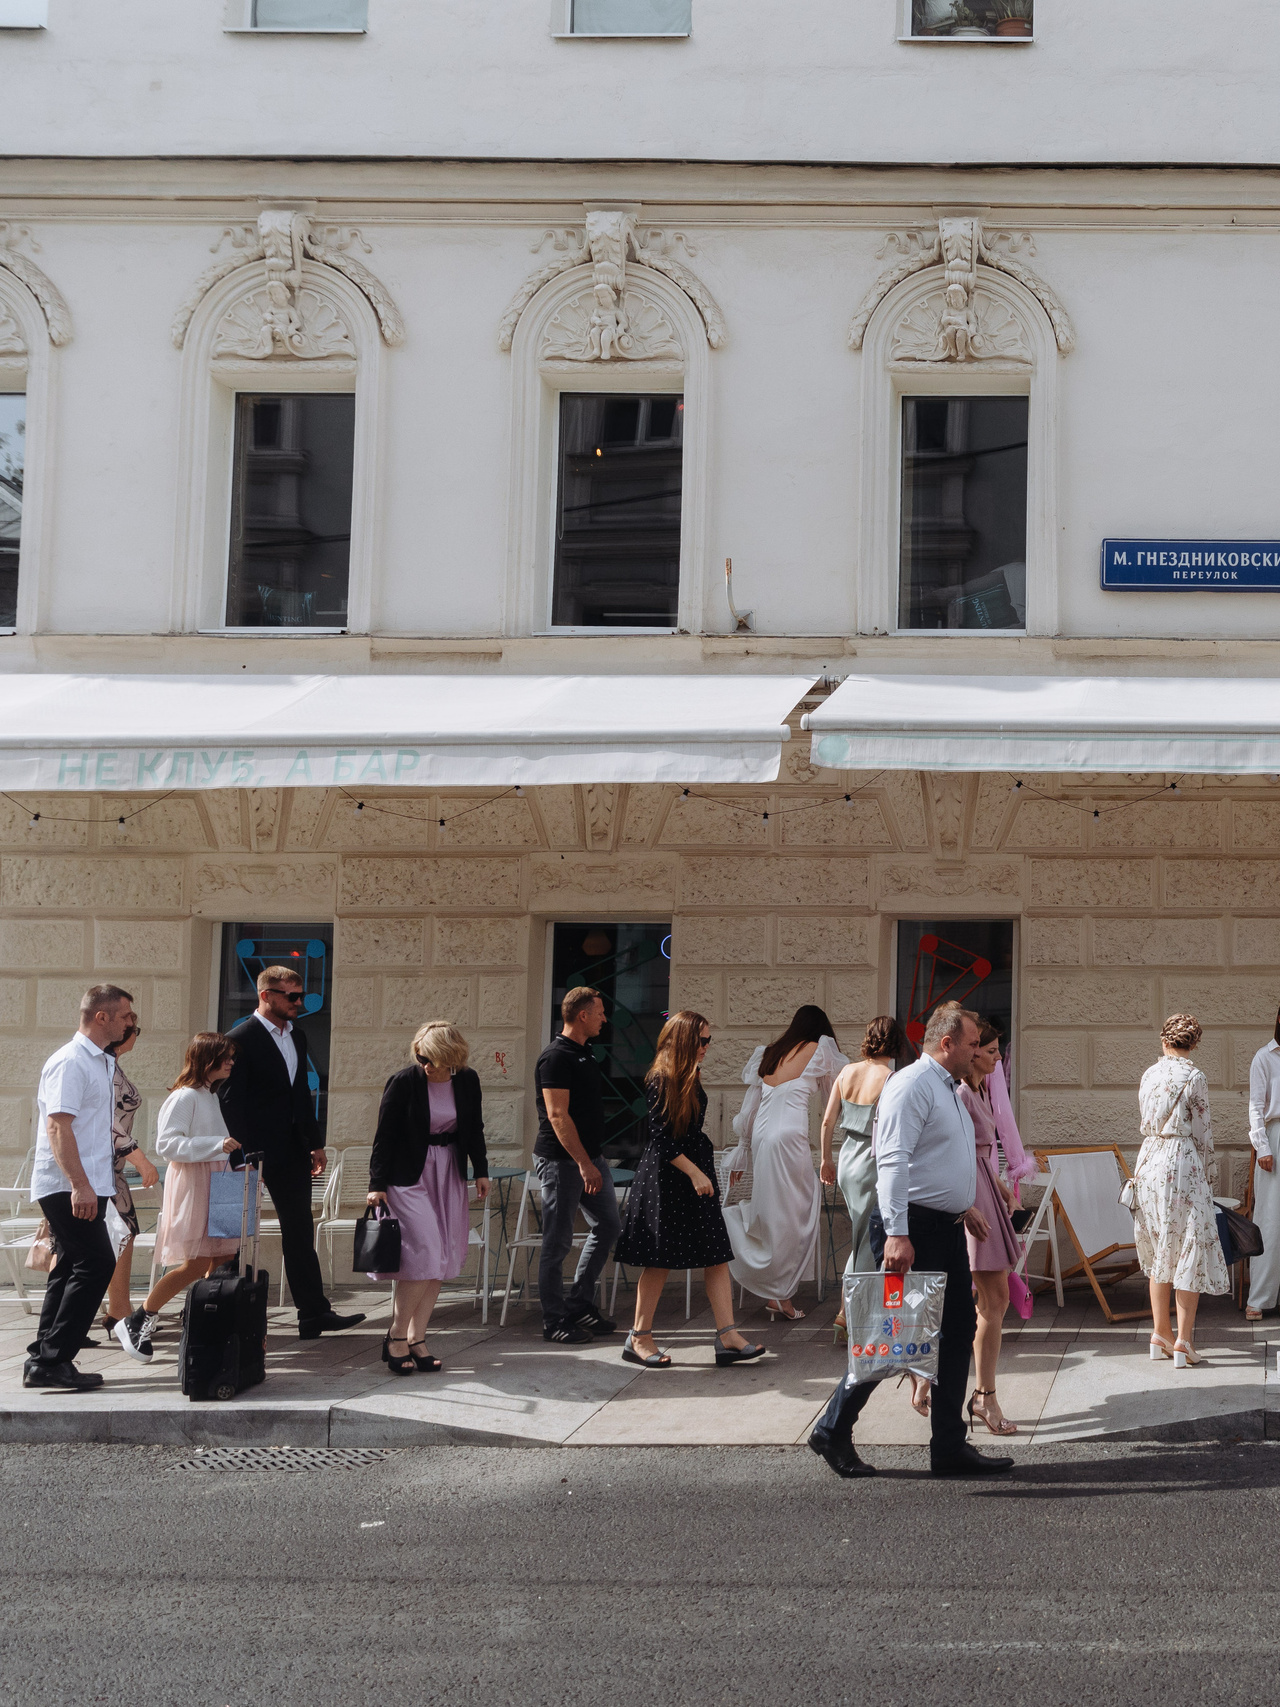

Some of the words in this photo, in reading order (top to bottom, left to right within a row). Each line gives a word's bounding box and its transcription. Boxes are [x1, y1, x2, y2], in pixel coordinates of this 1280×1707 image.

[1113, 552, 1132, 566] М.
[1173, 571, 1238, 579] ПЕРЕУЛОК
[57, 752, 118, 785] НЕ
[136, 750, 267, 786] КЛУБ,
[285, 750, 314, 783] А
[332, 749, 420, 782] БАР
